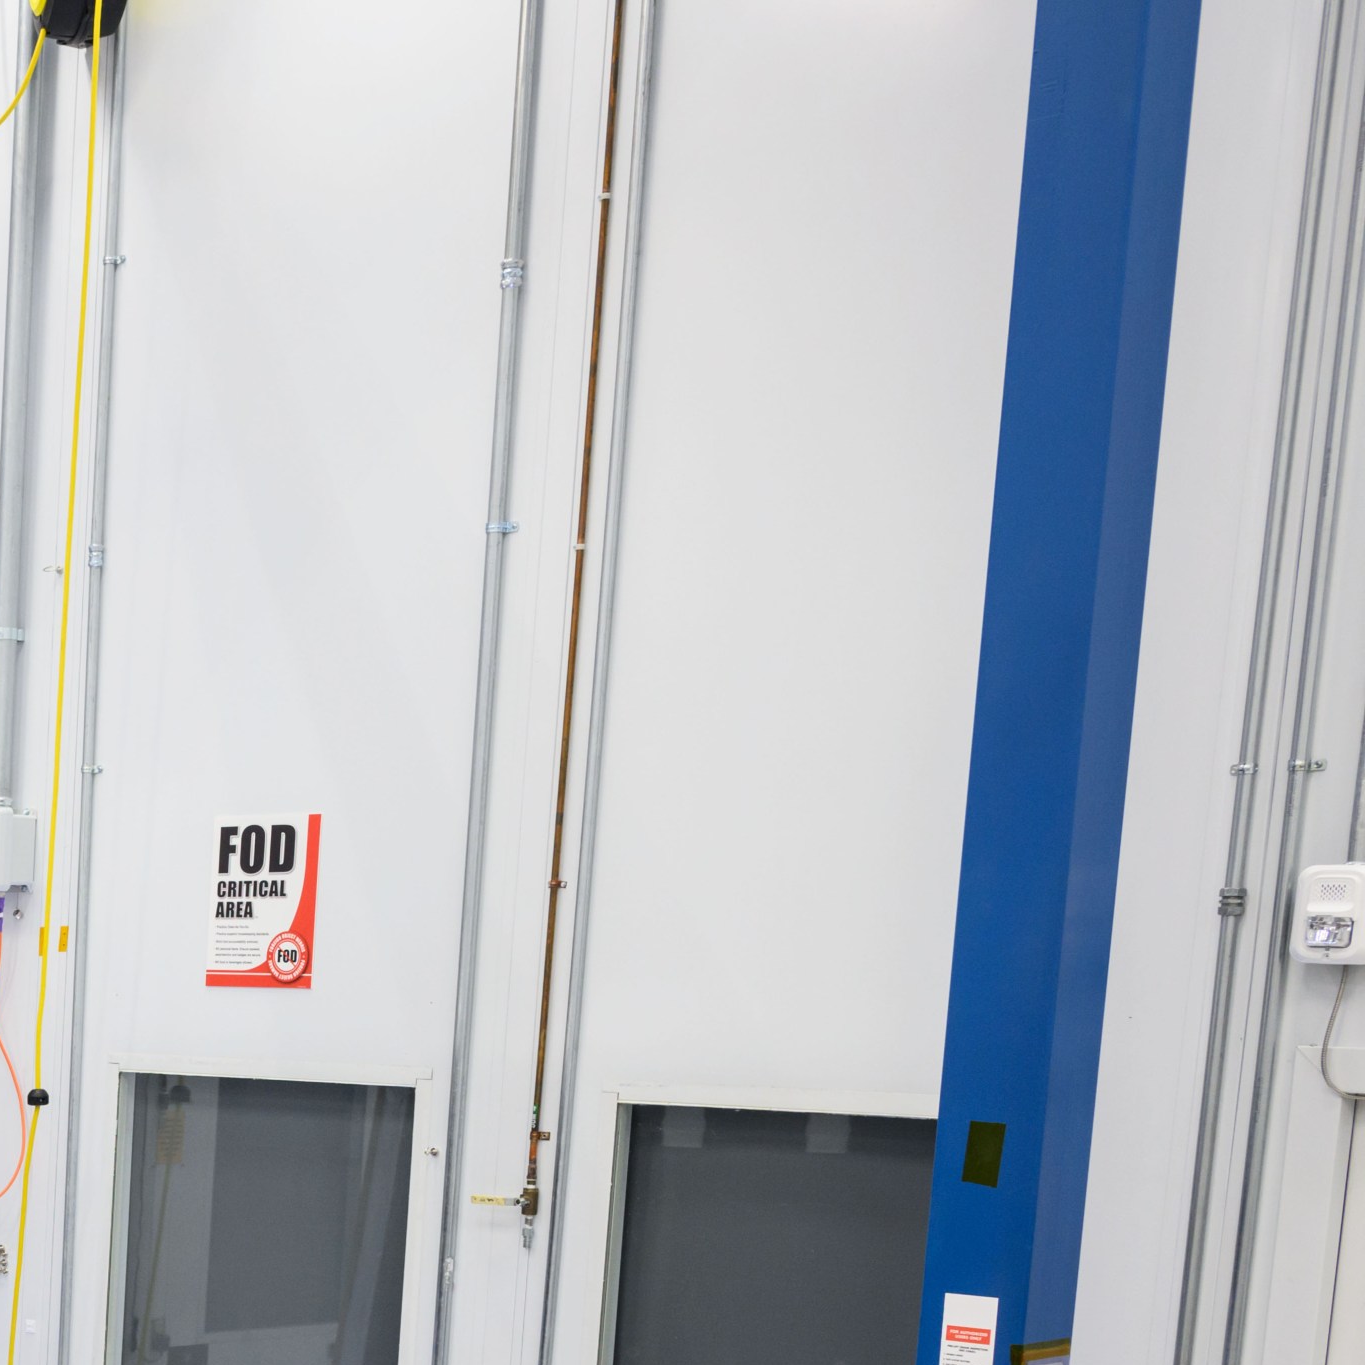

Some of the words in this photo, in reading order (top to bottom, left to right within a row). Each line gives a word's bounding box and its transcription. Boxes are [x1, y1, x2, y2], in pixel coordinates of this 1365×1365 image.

[218, 824, 296, 874] FOD
[217, 880, 286, 898] CRITICAL
[215, 901, 253, 918] AREA
[277, 949, 298, 963] FOD
